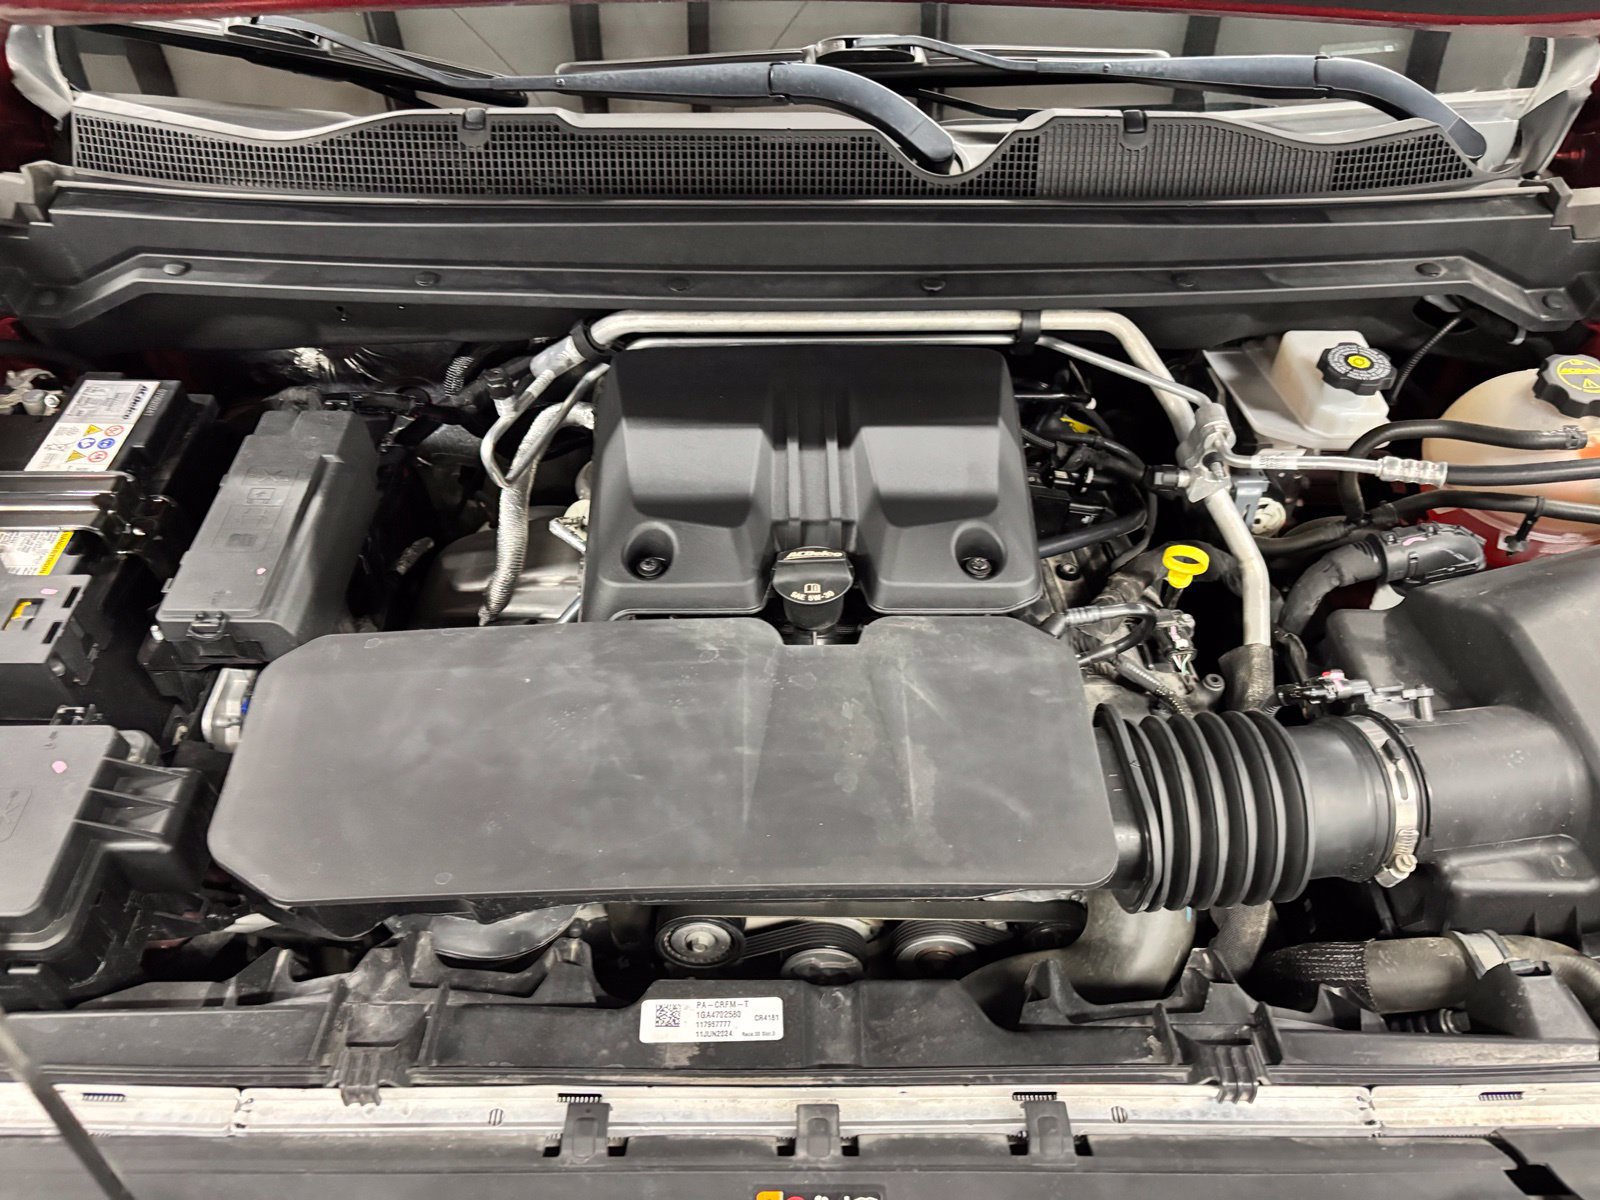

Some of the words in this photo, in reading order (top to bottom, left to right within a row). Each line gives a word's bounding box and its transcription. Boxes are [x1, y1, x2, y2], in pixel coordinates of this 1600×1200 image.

[122, 384, 148, 420] ACDelco
[783, 551, 843, 561] ACDelco
[790, 591, 807, 601] SAE
[807, 590, 835, 602] 5W-30
